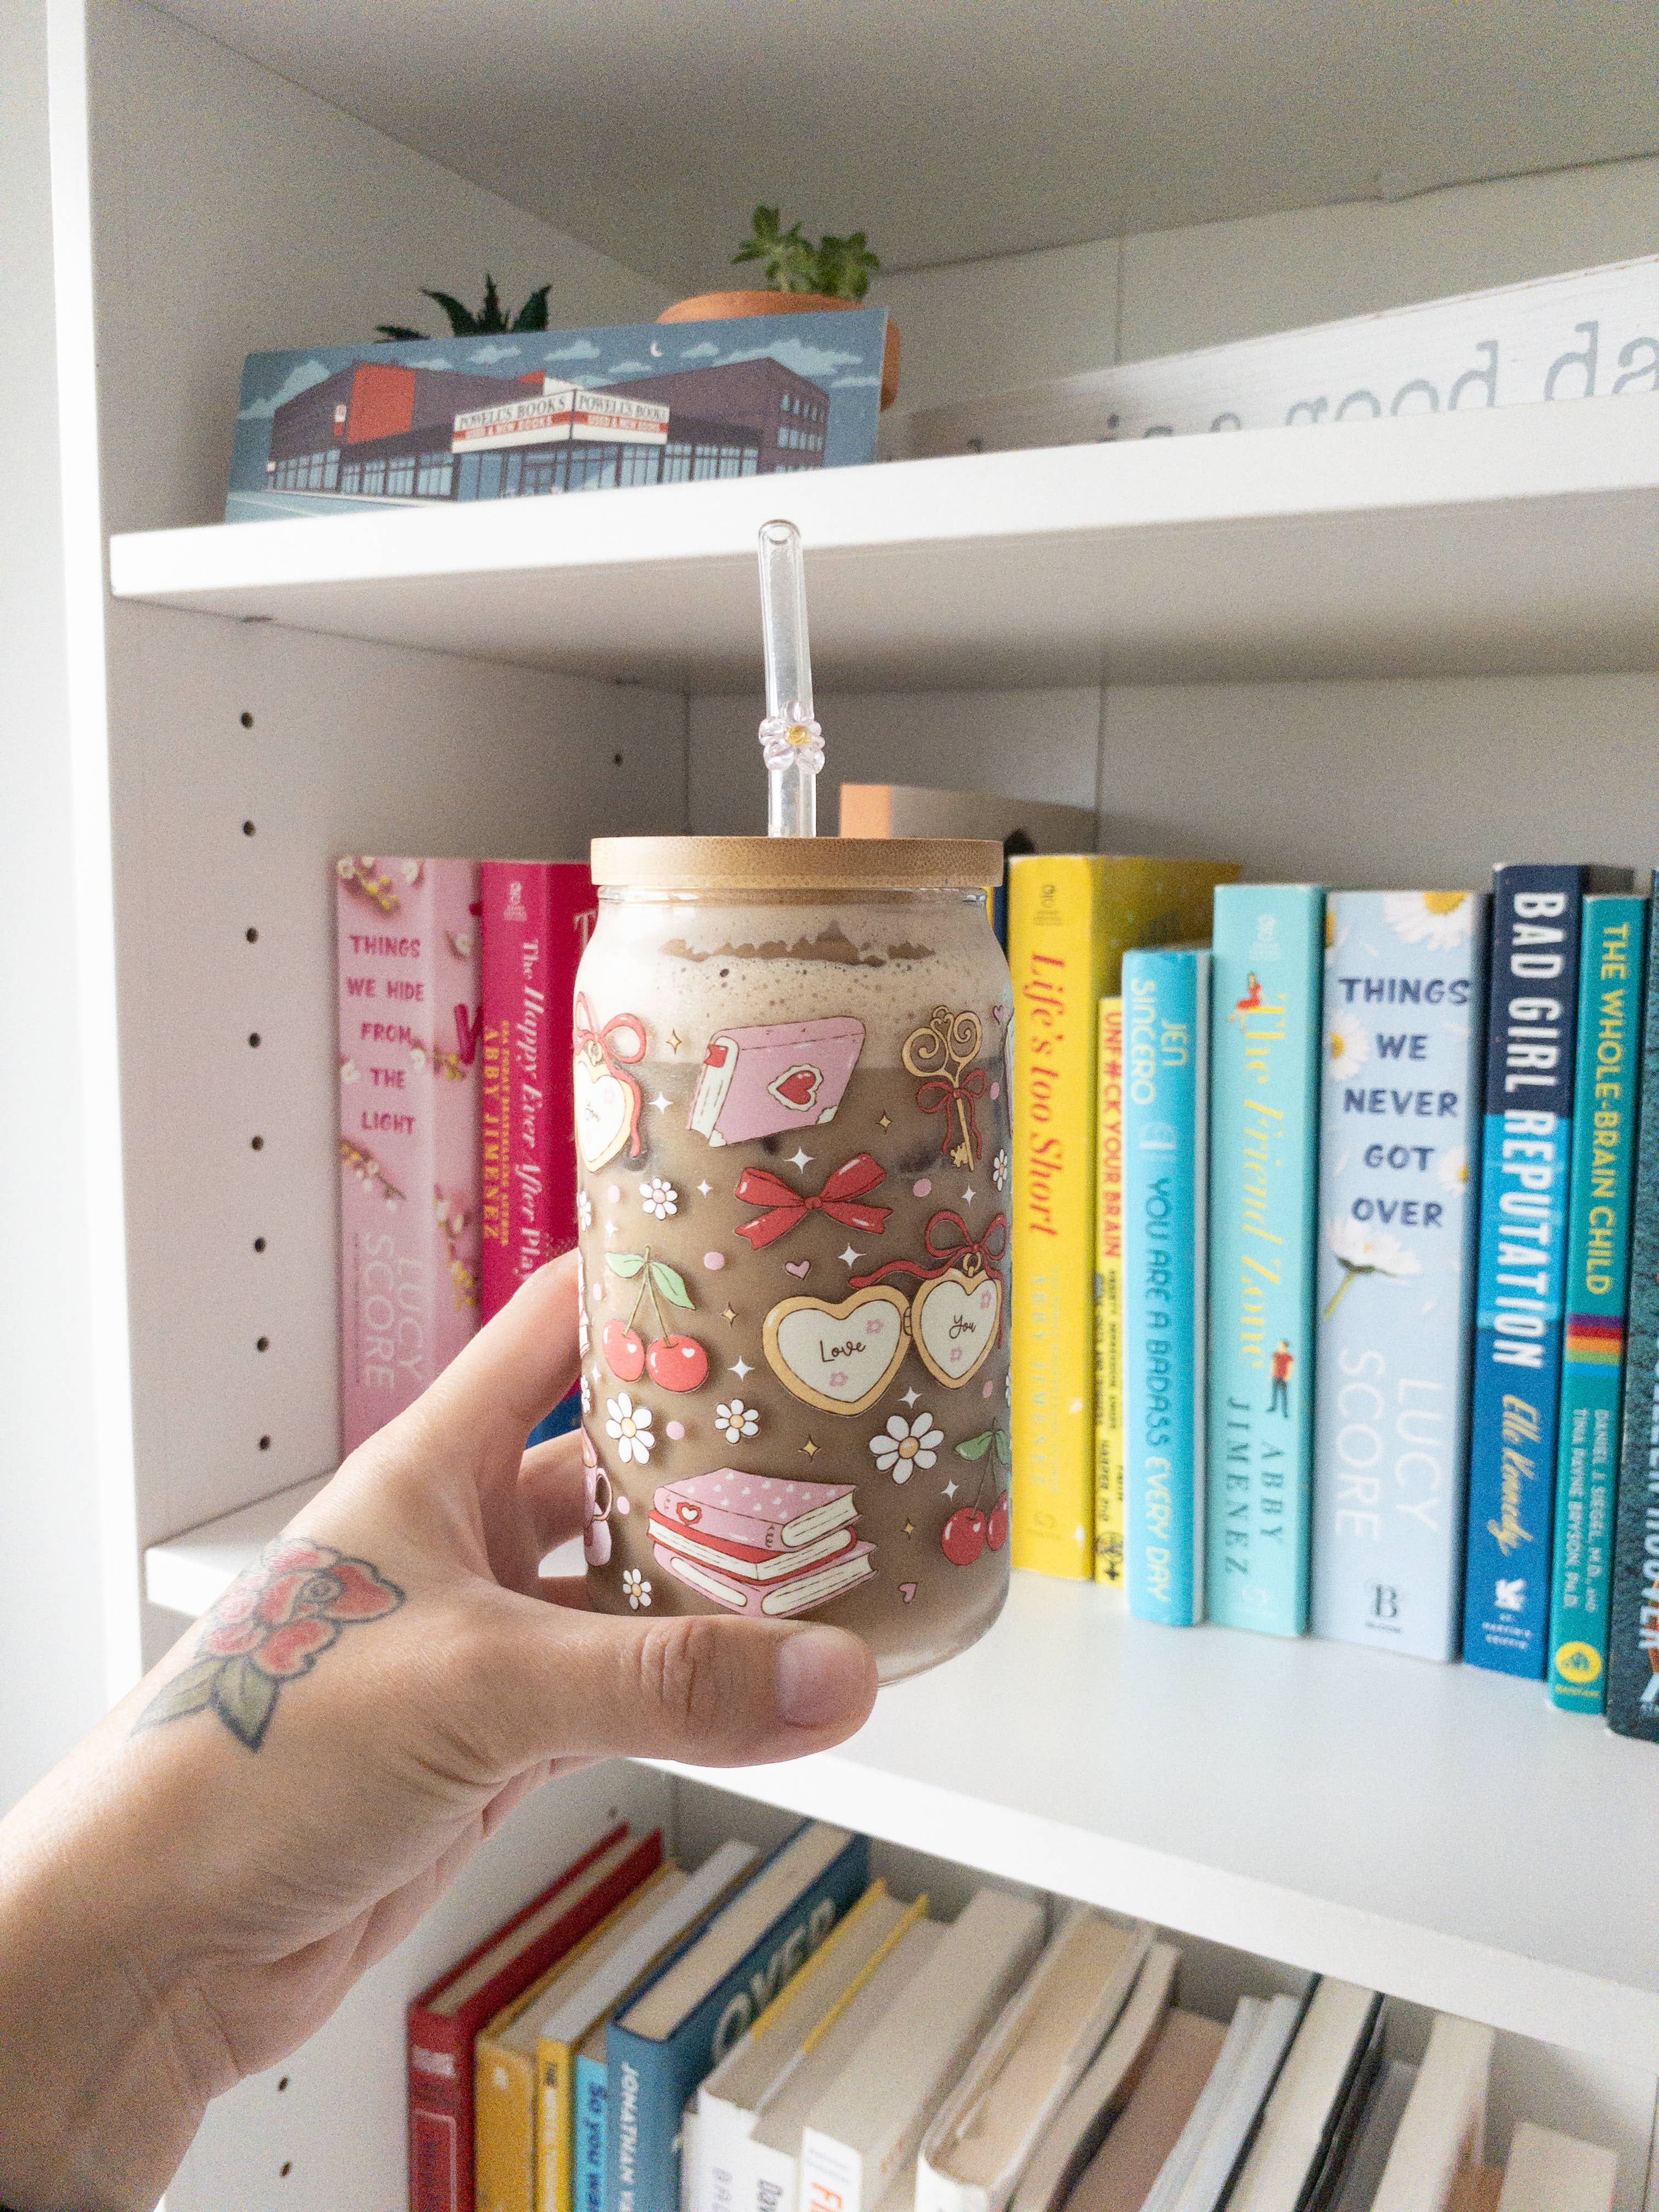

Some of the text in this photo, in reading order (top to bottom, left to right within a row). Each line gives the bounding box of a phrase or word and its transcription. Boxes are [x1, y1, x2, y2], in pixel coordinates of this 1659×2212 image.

[517, 395, 566, 418] BOOKS
[350, 934, 421, 957] THINGS
[522, 939, 540, 980] The
[346, 978, 424, 1001] WE HIDE
[1022, 952, 1065, 1055] Life's
[1338, 977, 1471, 1005] THINGS
[362, 1023, 411, 1043] FROM
[516, 985, 544, 1080] Happy
[1131, 978, 1156, 1105] SINCERO
[1161, 1019, 1188, 1066] JEN
[1376, 1033, 1429, 1060] WE
[370, 1068, 404, 1089] THE
[1343, 1088, 1459, 1118] NEVER
[1587, 922, 1630, 1295] THE WHOLE-BRAIN CHILD
[362, 1111, 415, 1135] LIGHT
[483, 1026, 500, 1239] ABBY JIMENEZ
[522, 1084, 543, 1148] Ever
[1492, 892, 1567, 1368] BAD GIRL REPUTATION
[1029, 1132, 1063, 1235] Short
[1103, 1121, 1122, 1183] YOUR
[1240, 994, 1285, 1368] The Friend Zone
[1364, 1144, 1435, 1172] GOT
[515, 1154, 542, 1222] After
[1351, 1197, 1444, 1228] OVER
[1103, 1190, 1122, 1258] BRAIN
[363, 1232, 395, 1389] SCORE
[397, 1257, 425, 1381] LUCY
[948, 1314, 977, 1339] You
[819, 1339, 866, 1364] Love
[1144, 1177, 1172, 1601] YOU ARE A BADASS EVERY DAY
[1334, 1348, 1385, 1539] SCORE
[1394, 1378, 1445, 1531] LUCY
[1571, 1408, 1588, 1444] TINA
[1592, 1409, 1609, 1464] DANIEL
[1224, 1397, 1250, 1575] JIMENEZ
[1260, 1442, 1285, 1544] ABBY
[1487, 1394, 1541, 1556] Elle Kennedy
[1568, 1448, 1586, 1498] PAYNE
[619, 2061, 640, 2184] JONATHAN
